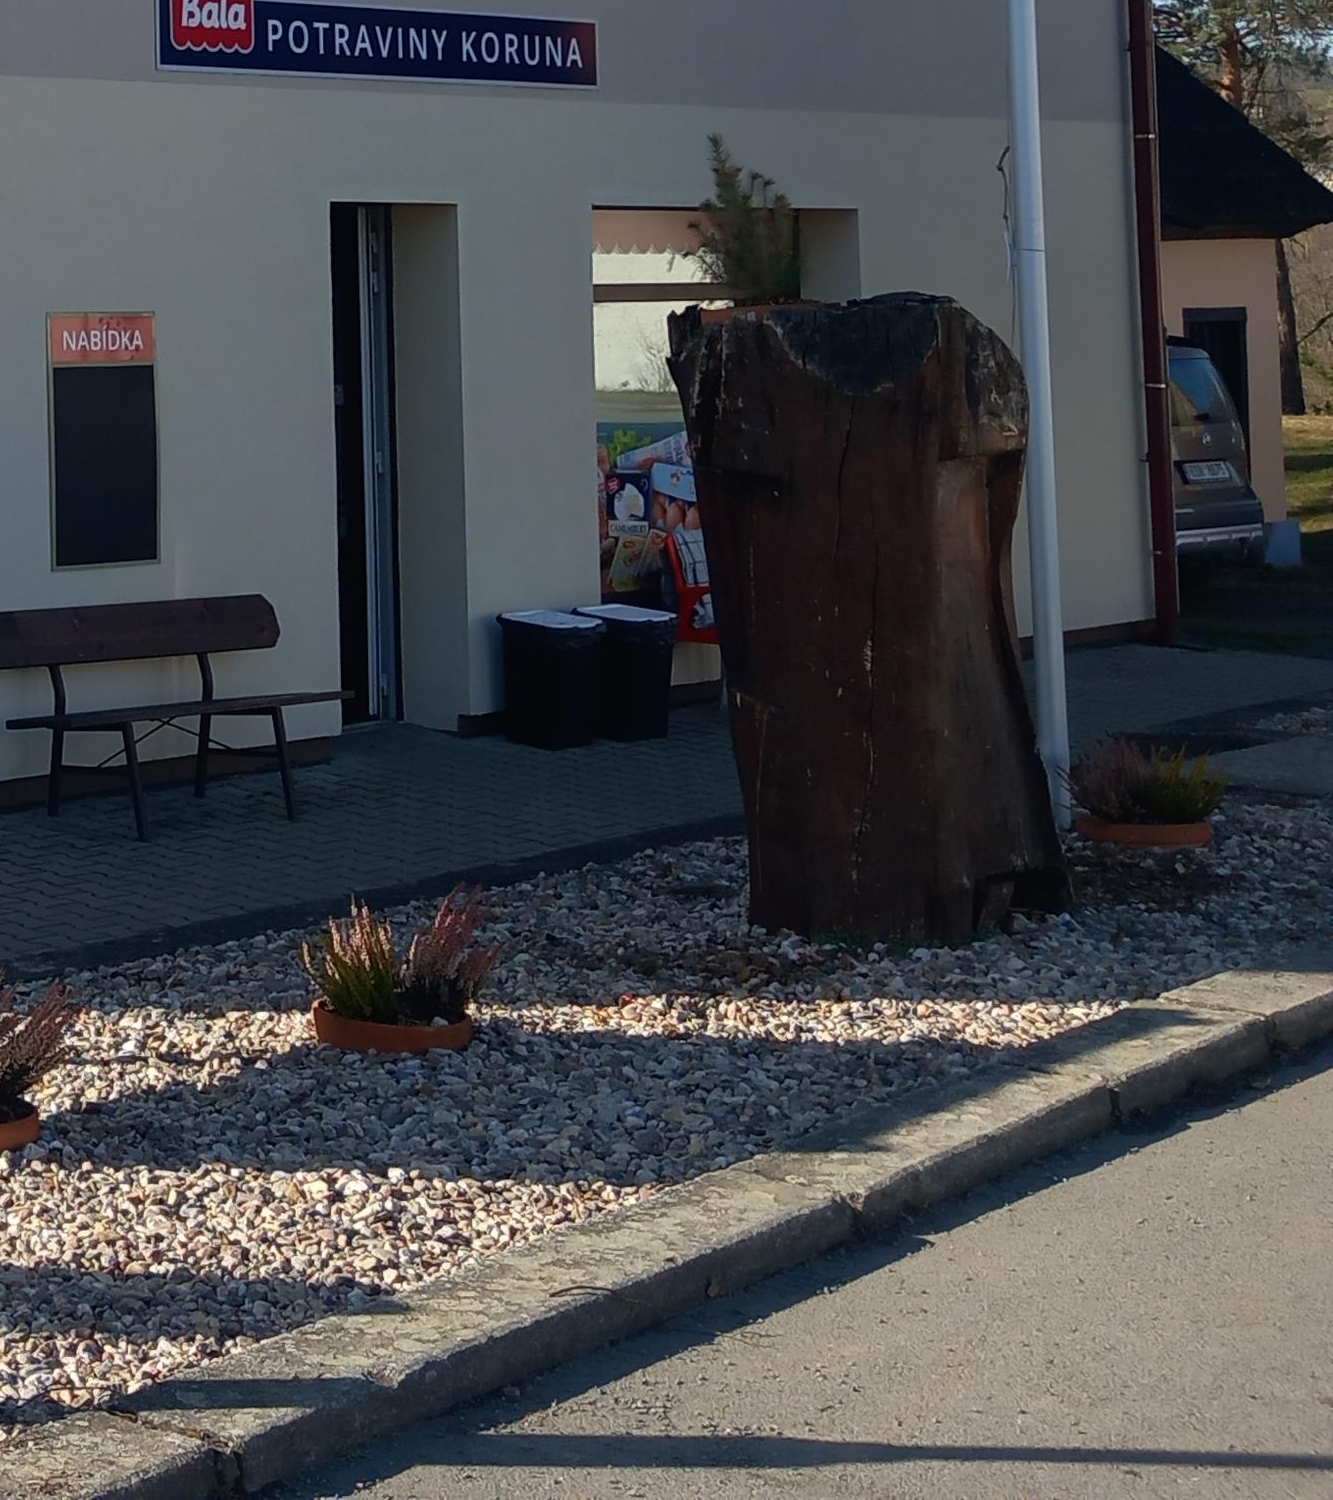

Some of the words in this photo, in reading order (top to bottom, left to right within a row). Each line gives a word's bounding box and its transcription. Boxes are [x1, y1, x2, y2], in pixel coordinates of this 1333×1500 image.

[266, 19, 448, 61] POTRAVINY
[461, 30, 584, 68] KORUNA
[62, 325, 144, 351] NABÍDKA
